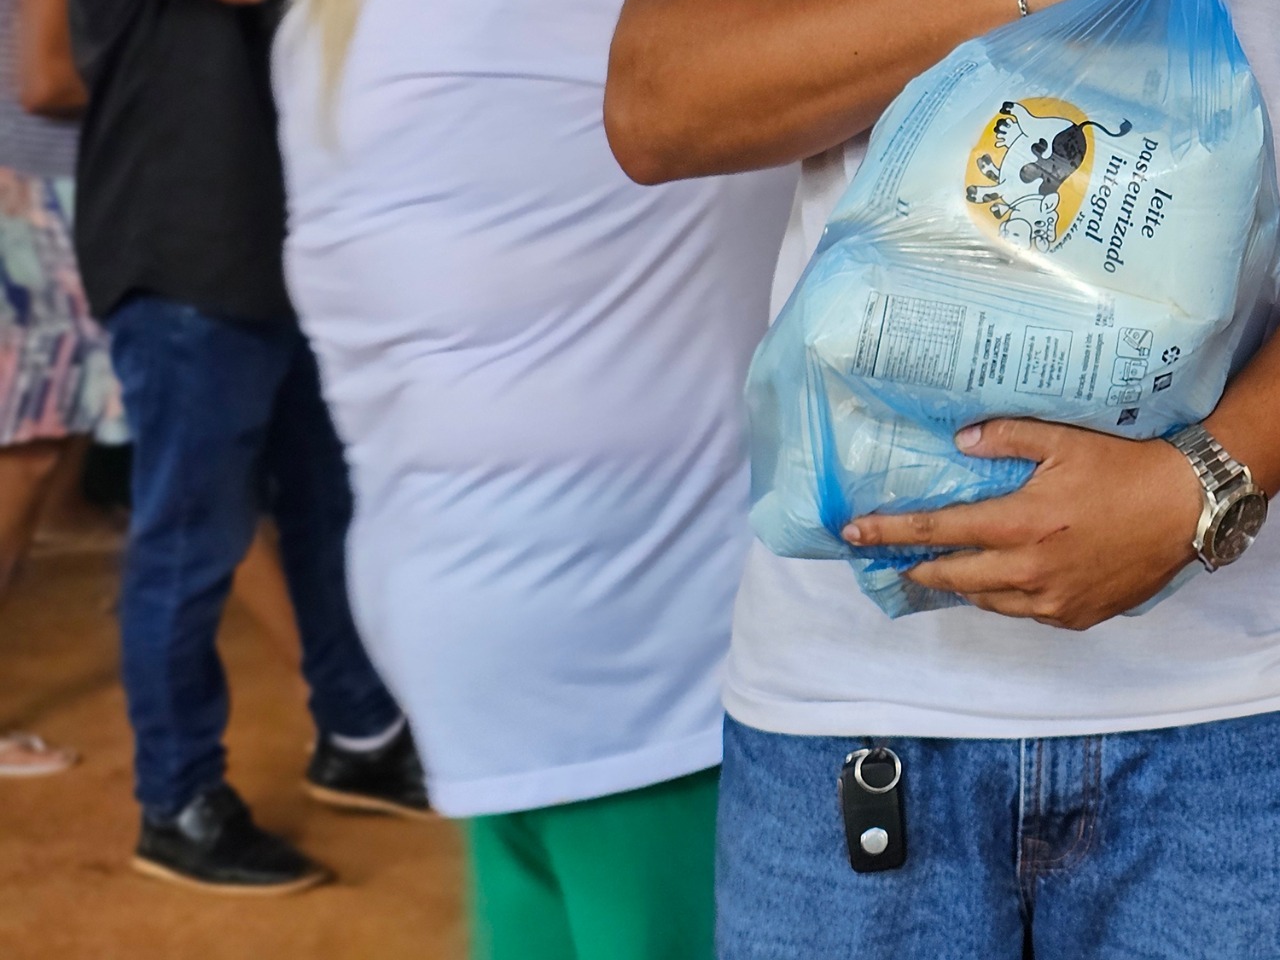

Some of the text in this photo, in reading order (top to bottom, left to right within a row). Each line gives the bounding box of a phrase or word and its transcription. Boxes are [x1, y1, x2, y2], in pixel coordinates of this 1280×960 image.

[1085, 155, 1127, 243] integral
[1103, 137, 1159, 273] pasteurizado
[1141, 188, 1173, 239] leite
